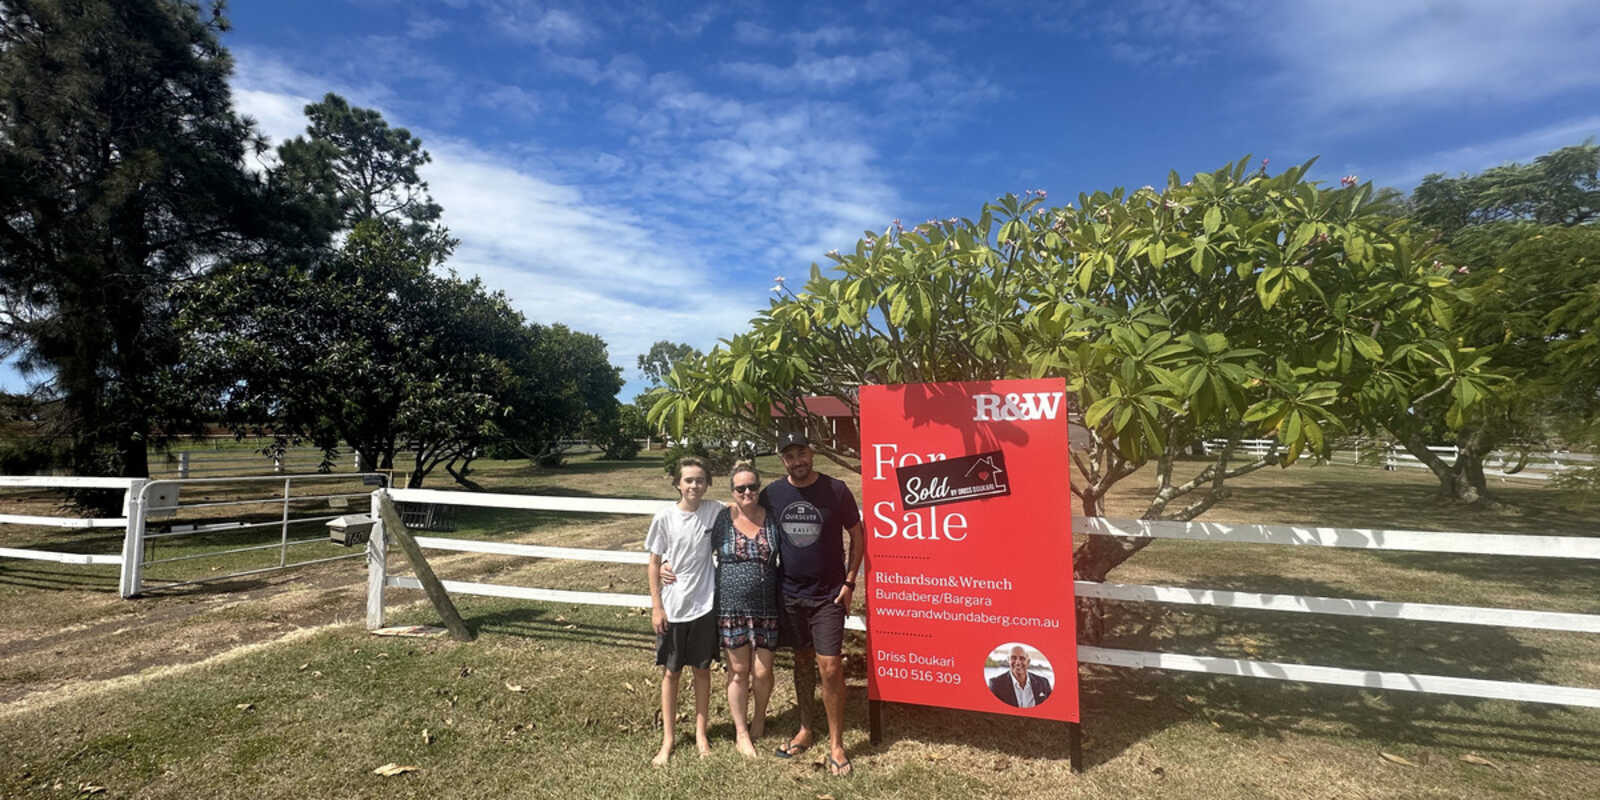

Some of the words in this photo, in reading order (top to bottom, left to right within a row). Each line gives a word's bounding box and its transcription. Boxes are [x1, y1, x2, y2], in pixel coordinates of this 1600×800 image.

[972, 392, 1063, 421] R&W
[904, 476, 950, 505] Sold
[873, 501, 968, 541] Sale
[875, 571, 1012, 590] Richardson&Wrench
[875, 588, 992, 607] Bundaberg/Bargara
[876, 607, 1059, 628] www.randwbundaberg.com.au
[877, 650, 906, 663] Driss
[908, 652, 955, 667] Doukari
[877, 666, 908, 679] 0410
[911, 669, 933, 682] 516
[936, 671, 961, 685] 309
